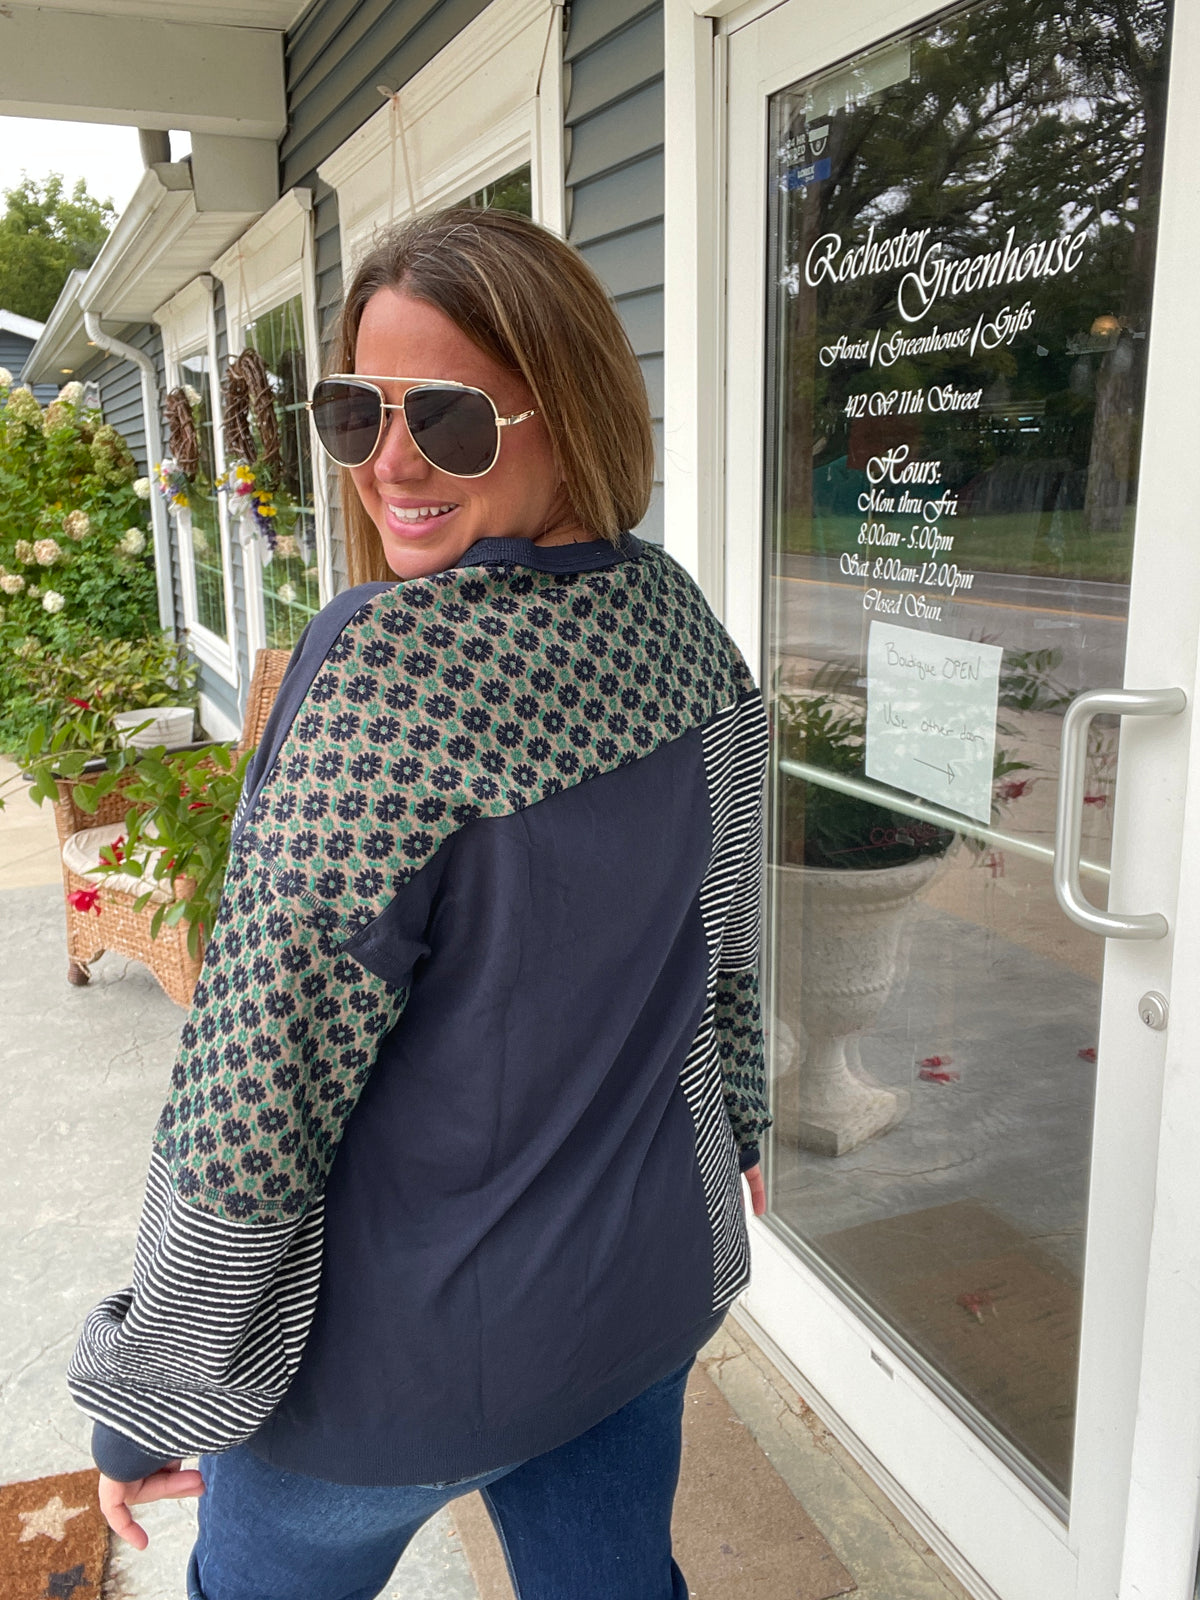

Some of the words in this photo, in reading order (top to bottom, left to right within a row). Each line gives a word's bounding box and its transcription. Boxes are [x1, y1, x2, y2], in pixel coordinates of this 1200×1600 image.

[805, 225, 931, 288] Rochester
[897, 226, 1087, 323] Greenhouse
[844, 393, 868, 418] 412
[898, 388, 924, 415] 11th
[927, 383, 983, 412] Street
[866, 444, 942, 485] Hours:
[897, 489, 923, 514] thru
[857, 522, 901, 547] 8:00am
[906, 525, 955, 559] 5:00pm
[862, 587, 904, 615] Closed
[904, 593, 942, 622] Sun.
[884, 641, 937, 681] Boutique
[942, 655, 982, 681] OPEN
[883, 701, 908, 730] Use
[920, 719, 955, 737] other
[959, 724, 986, 743] door
